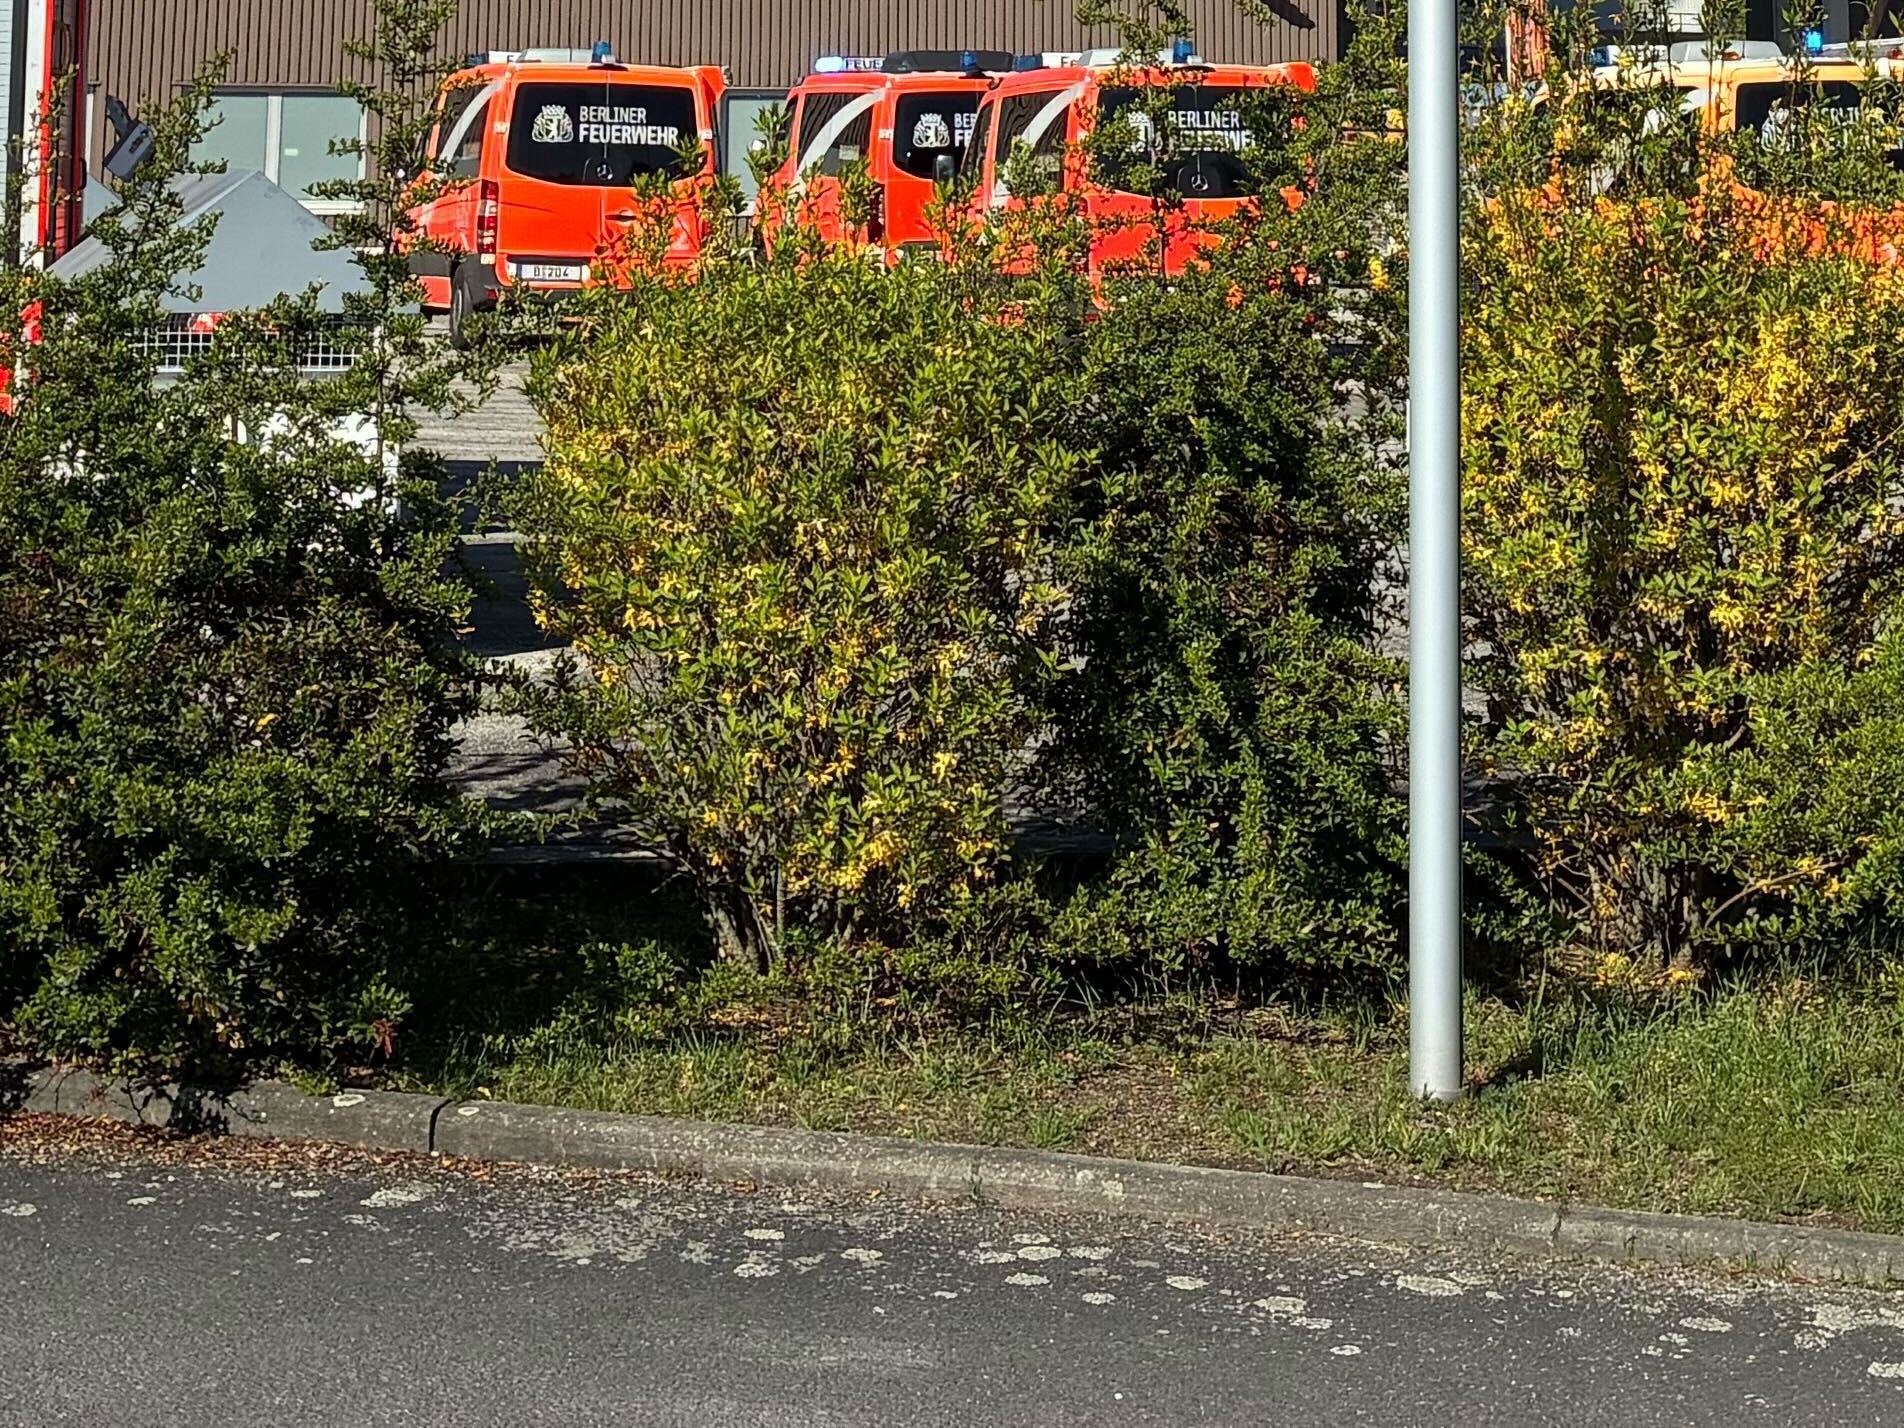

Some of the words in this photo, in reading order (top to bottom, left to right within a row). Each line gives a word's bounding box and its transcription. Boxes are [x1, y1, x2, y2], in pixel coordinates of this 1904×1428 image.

[579, 105, 647, 125] BERLINER
[1168, 110, 1240, 129] BERLINER
[579, 123, 679, 146] FEUERWEHR
